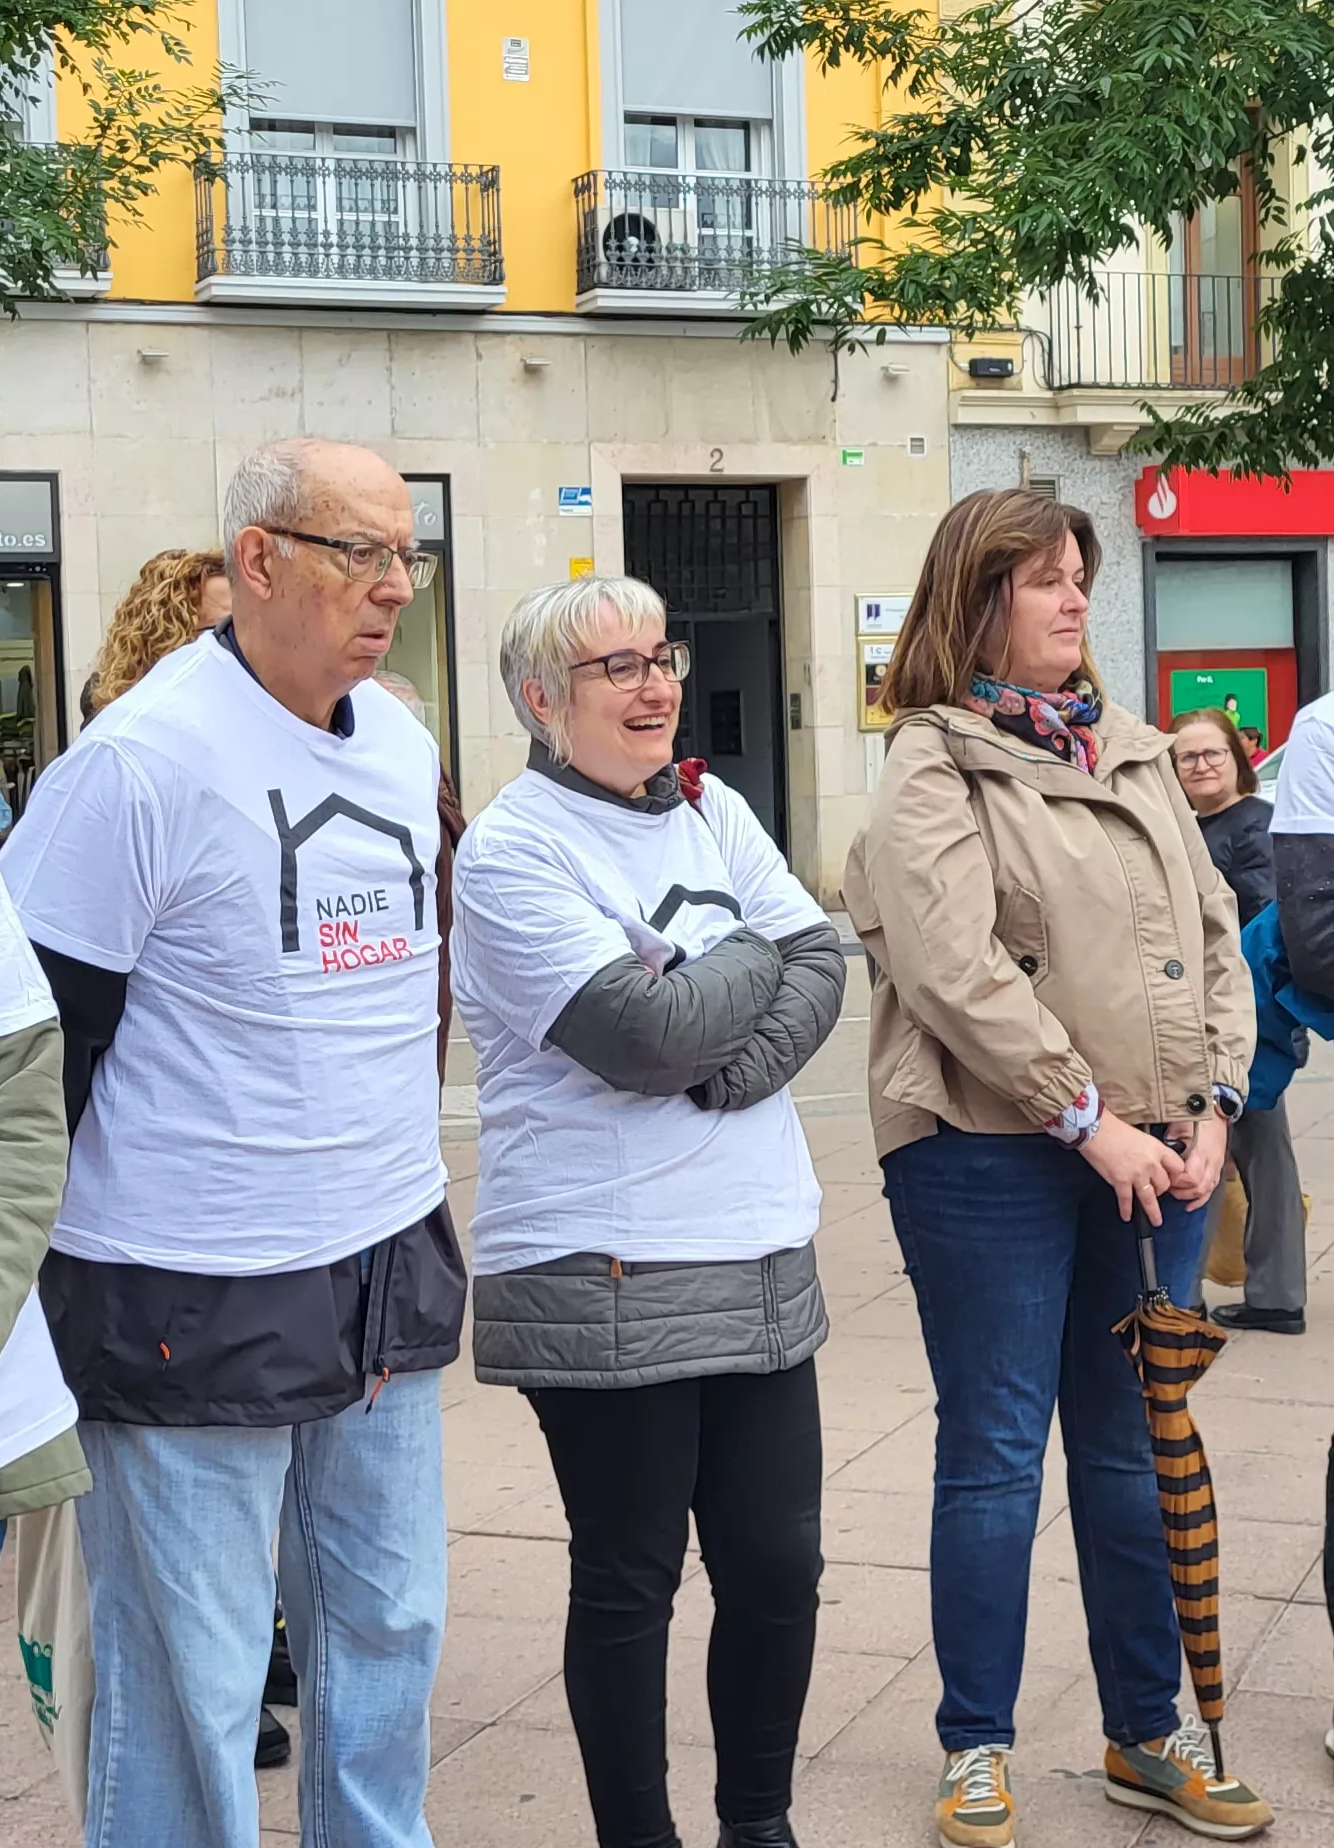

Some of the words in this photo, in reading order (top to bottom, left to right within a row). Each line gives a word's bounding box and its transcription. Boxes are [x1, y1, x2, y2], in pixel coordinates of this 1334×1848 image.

[710, 448, 724, 473] 2
[316, 889, 390, 920] NADIE
[319, 920, 359, 948] SIN
[322, 937, 414, 974] HOGAR
